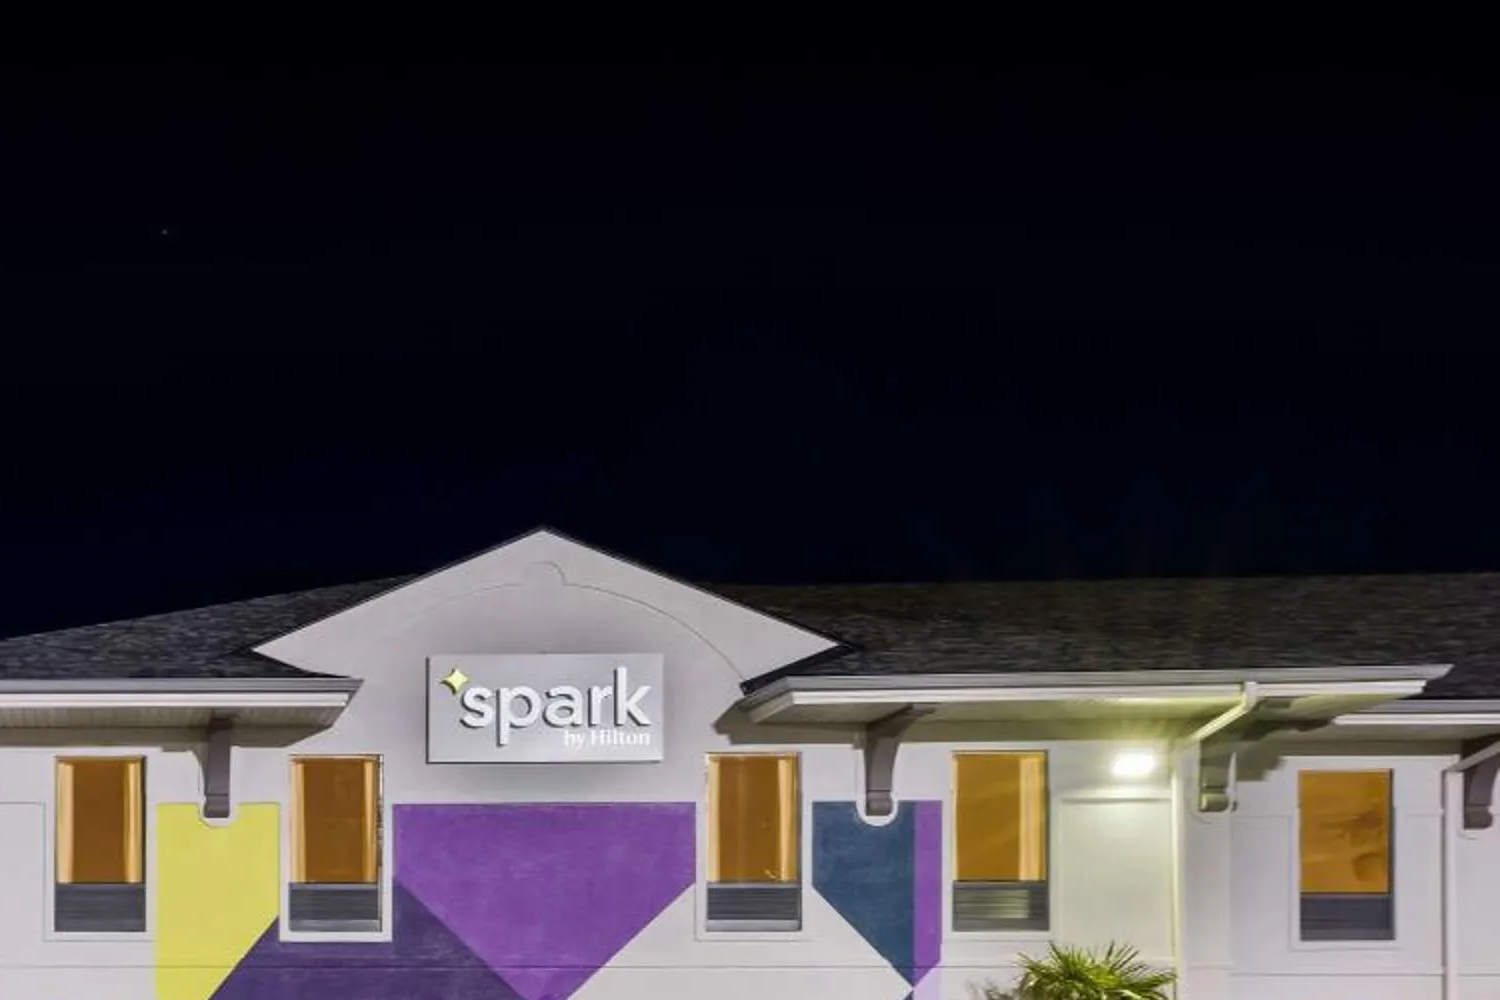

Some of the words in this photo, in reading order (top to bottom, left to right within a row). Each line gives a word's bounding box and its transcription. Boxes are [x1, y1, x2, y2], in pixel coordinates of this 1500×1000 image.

[460, 666, 652, 747] spark
[563, 729, 586, 751] by
[590, 729, 651, 747] Hilton
